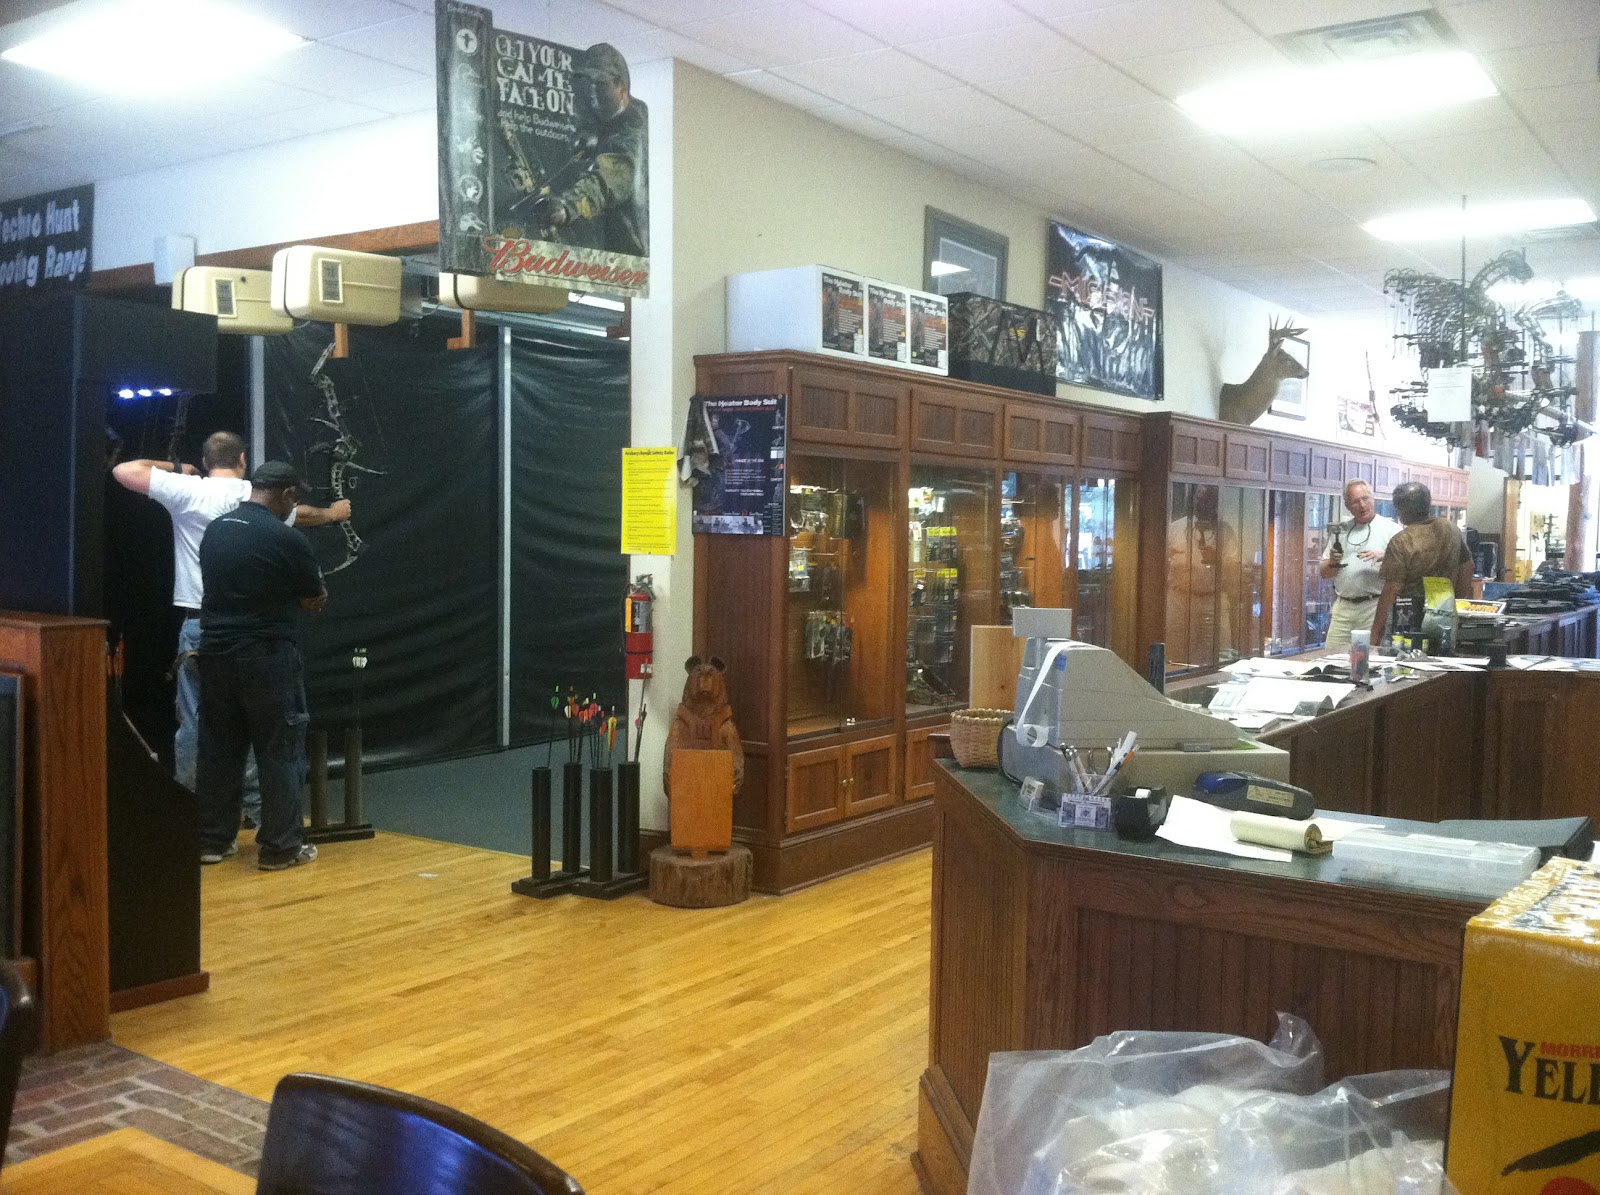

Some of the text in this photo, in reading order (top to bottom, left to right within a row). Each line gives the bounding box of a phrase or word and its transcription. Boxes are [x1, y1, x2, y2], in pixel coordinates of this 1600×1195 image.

[528, 42, 573, 72] YOUR
[546, 89, 575, 116] ON
[0, 199, 80, 244] echno Hunt
[44, 245, 87, 282] Range
[483, 236, 648, 285] Budweiser
[763, 398, 777, 406] Suit
